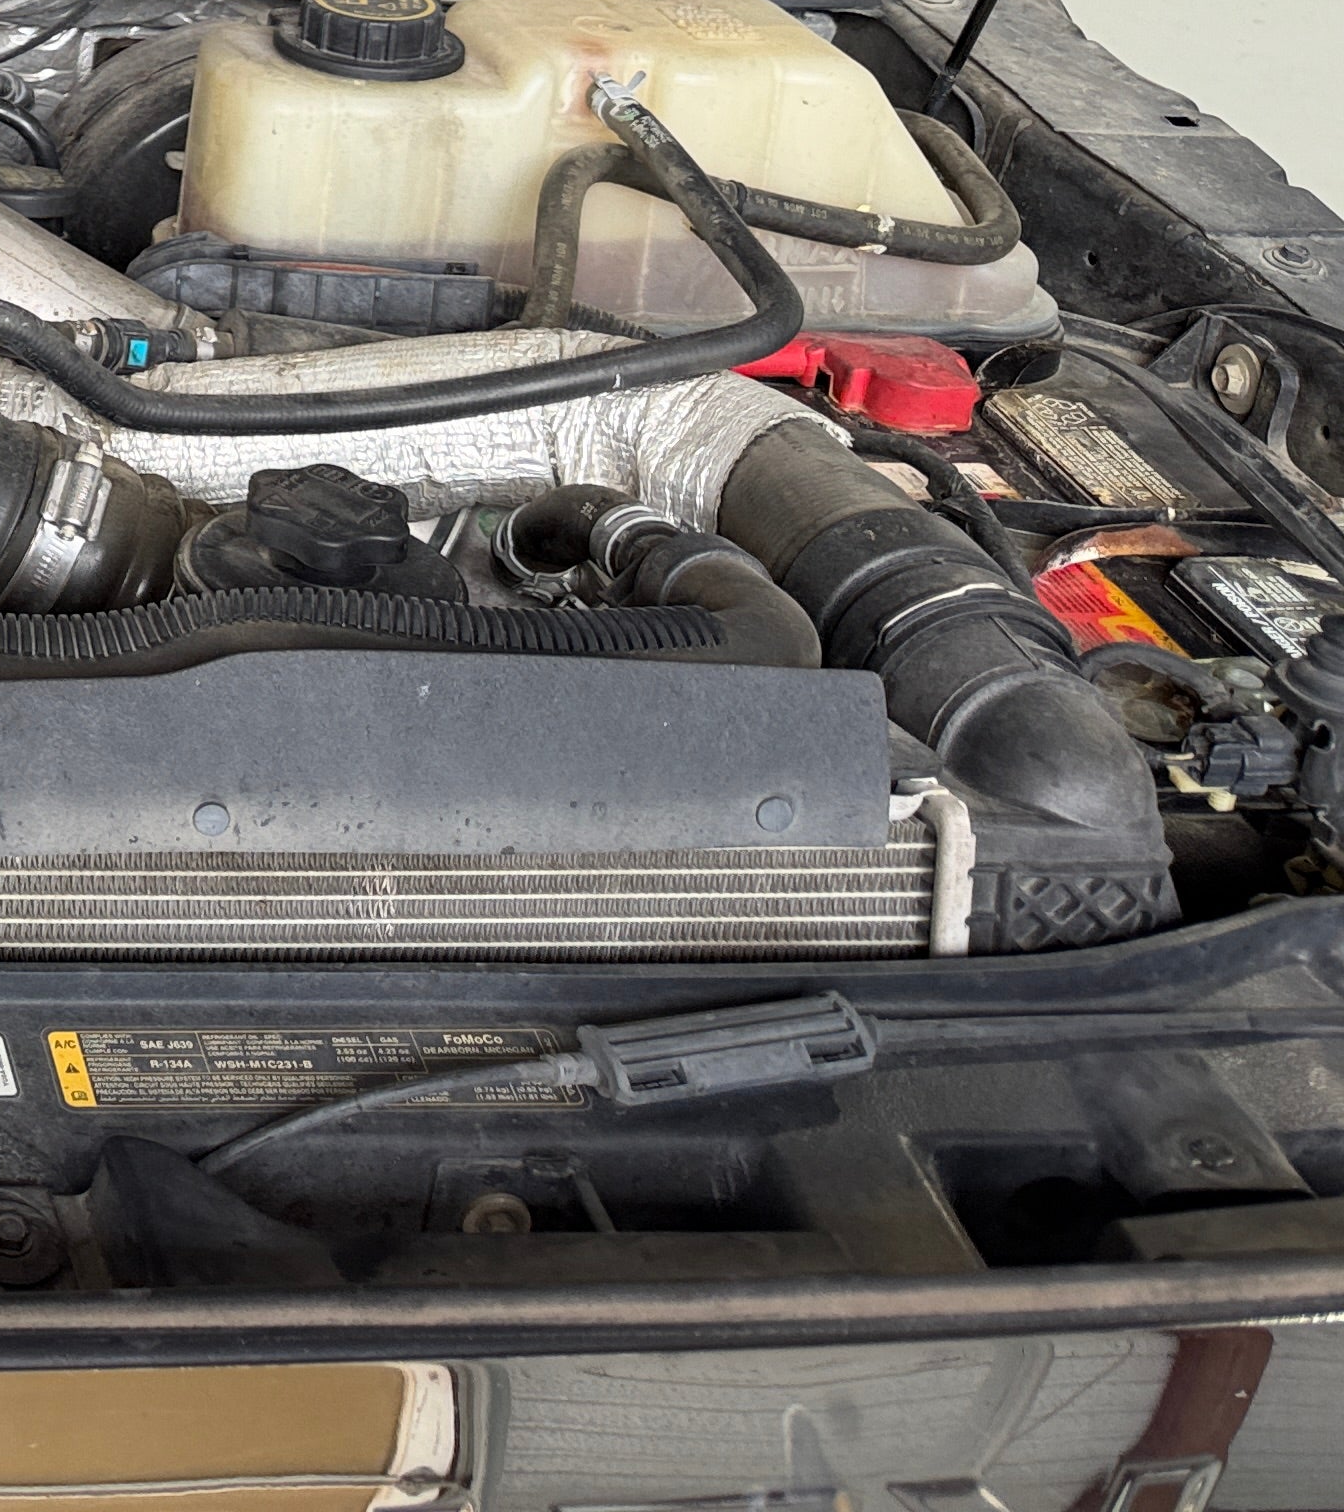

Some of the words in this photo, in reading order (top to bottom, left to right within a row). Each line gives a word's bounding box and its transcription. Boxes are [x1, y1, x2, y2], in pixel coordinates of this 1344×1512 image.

[443, 1034, 503, 1045] FoMoCo
[54, 1040, 77, 1049] A/C
[140, 1040, 164, 1049] SAE
[167, 1040, 194, 1049] J639
[150, 1059, 193, 1069] R-134A
[214, 1060, 313, 1069] WSH-M1C231-B
